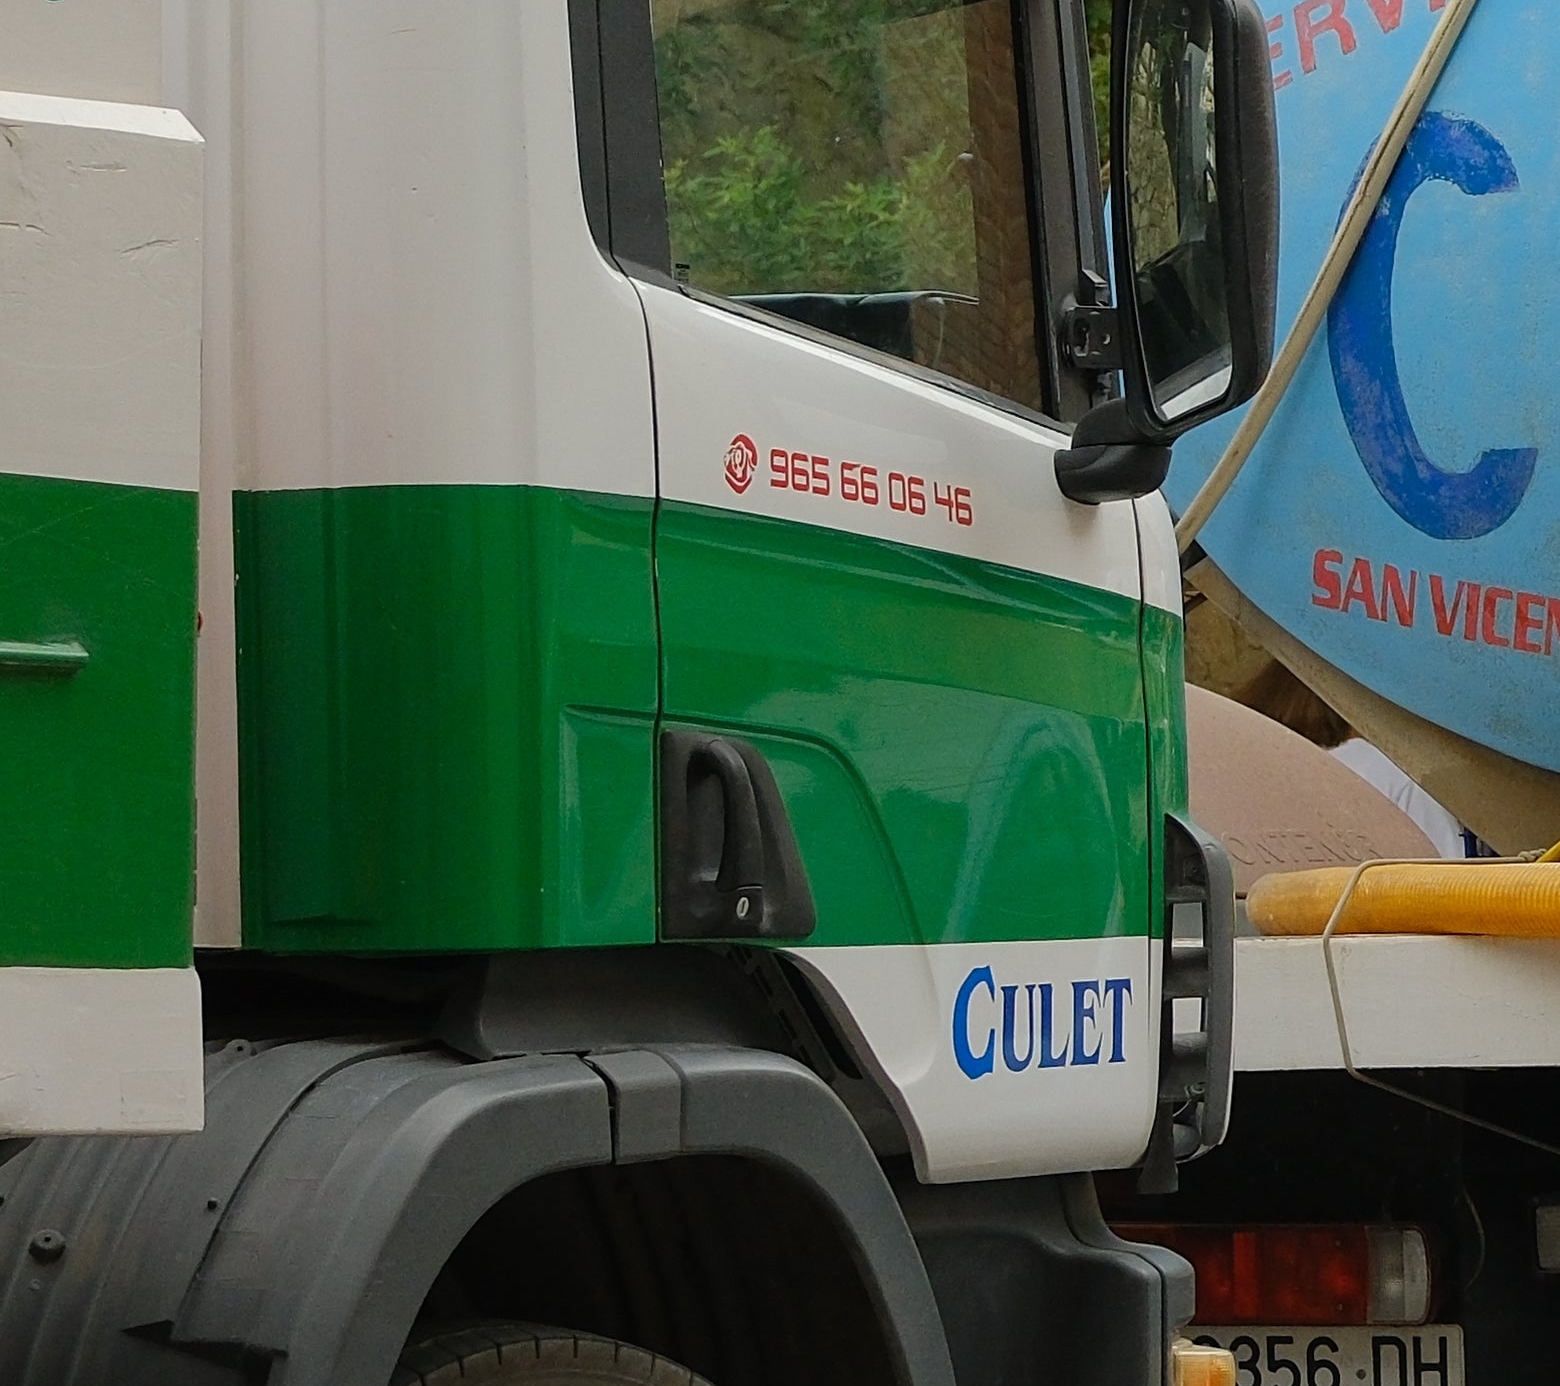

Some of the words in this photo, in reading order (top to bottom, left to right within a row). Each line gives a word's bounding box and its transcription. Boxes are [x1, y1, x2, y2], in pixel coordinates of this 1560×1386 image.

[770, 449, 831, 496] 965
[840, 462, 879, 506] 66
[888, 472, 927, 516] 06
[934, 481, 974, 527] 46
[1312, 548, 1418, 628] SAN
[952, 965, 1132, 1080] CULET
